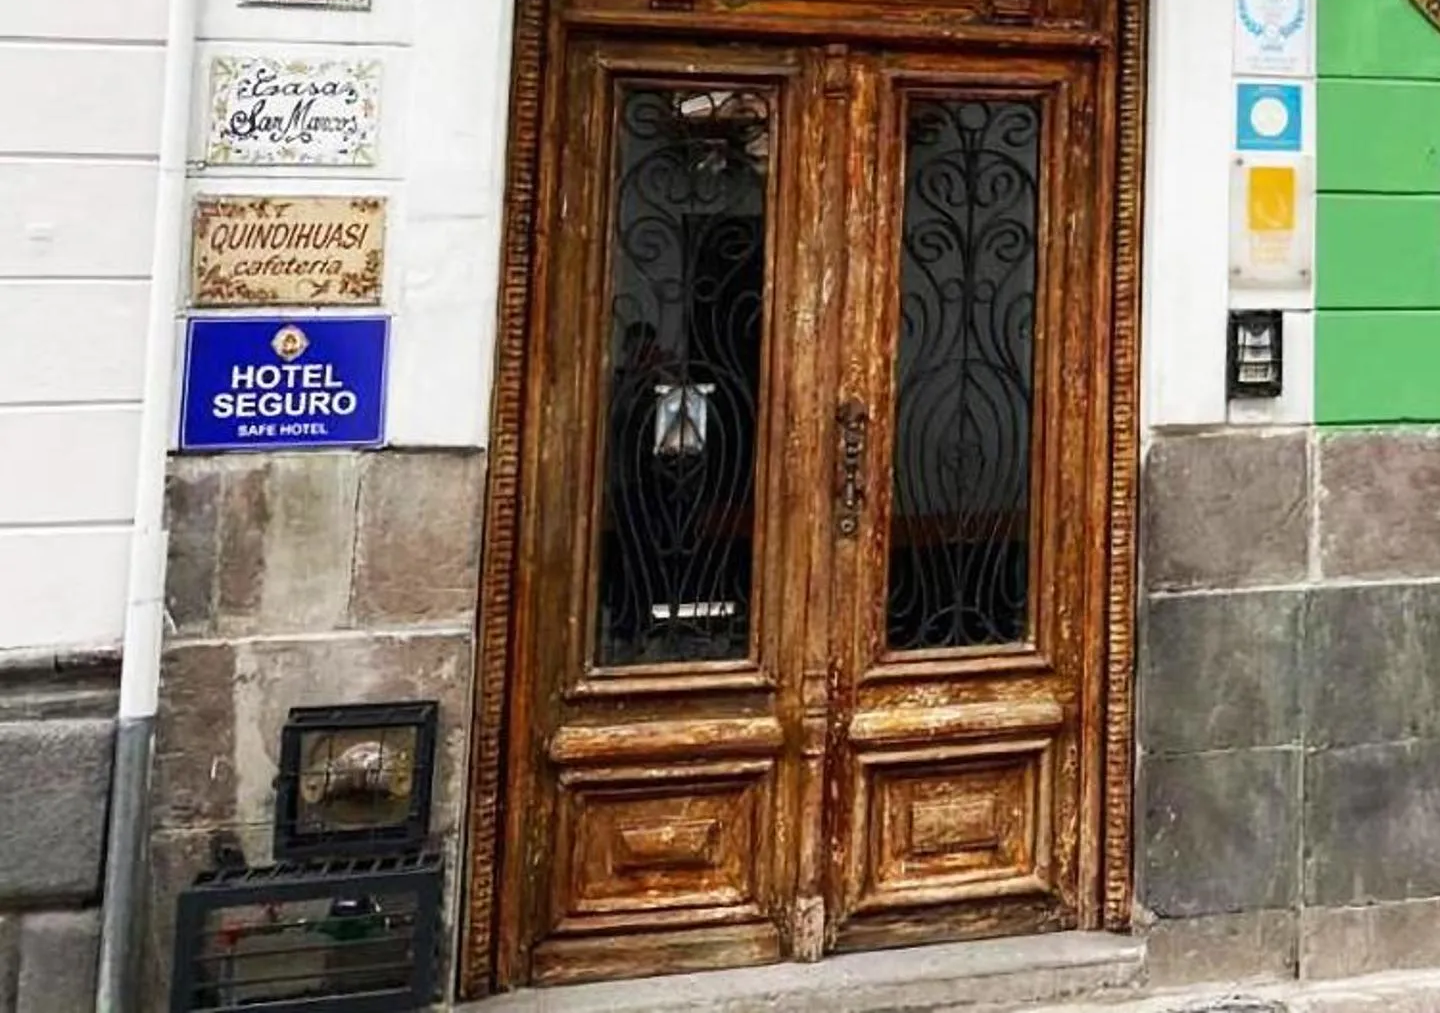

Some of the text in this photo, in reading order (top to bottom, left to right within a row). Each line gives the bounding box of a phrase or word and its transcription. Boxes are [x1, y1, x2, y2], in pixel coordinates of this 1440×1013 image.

[210, 222, 370, 254] QUINDIHUASI
[230, 363, 344, 390] HOTEL
[212, 390, 358, 419] SEGURO
[237, 421, 329, 437] SAFE HOTEL
